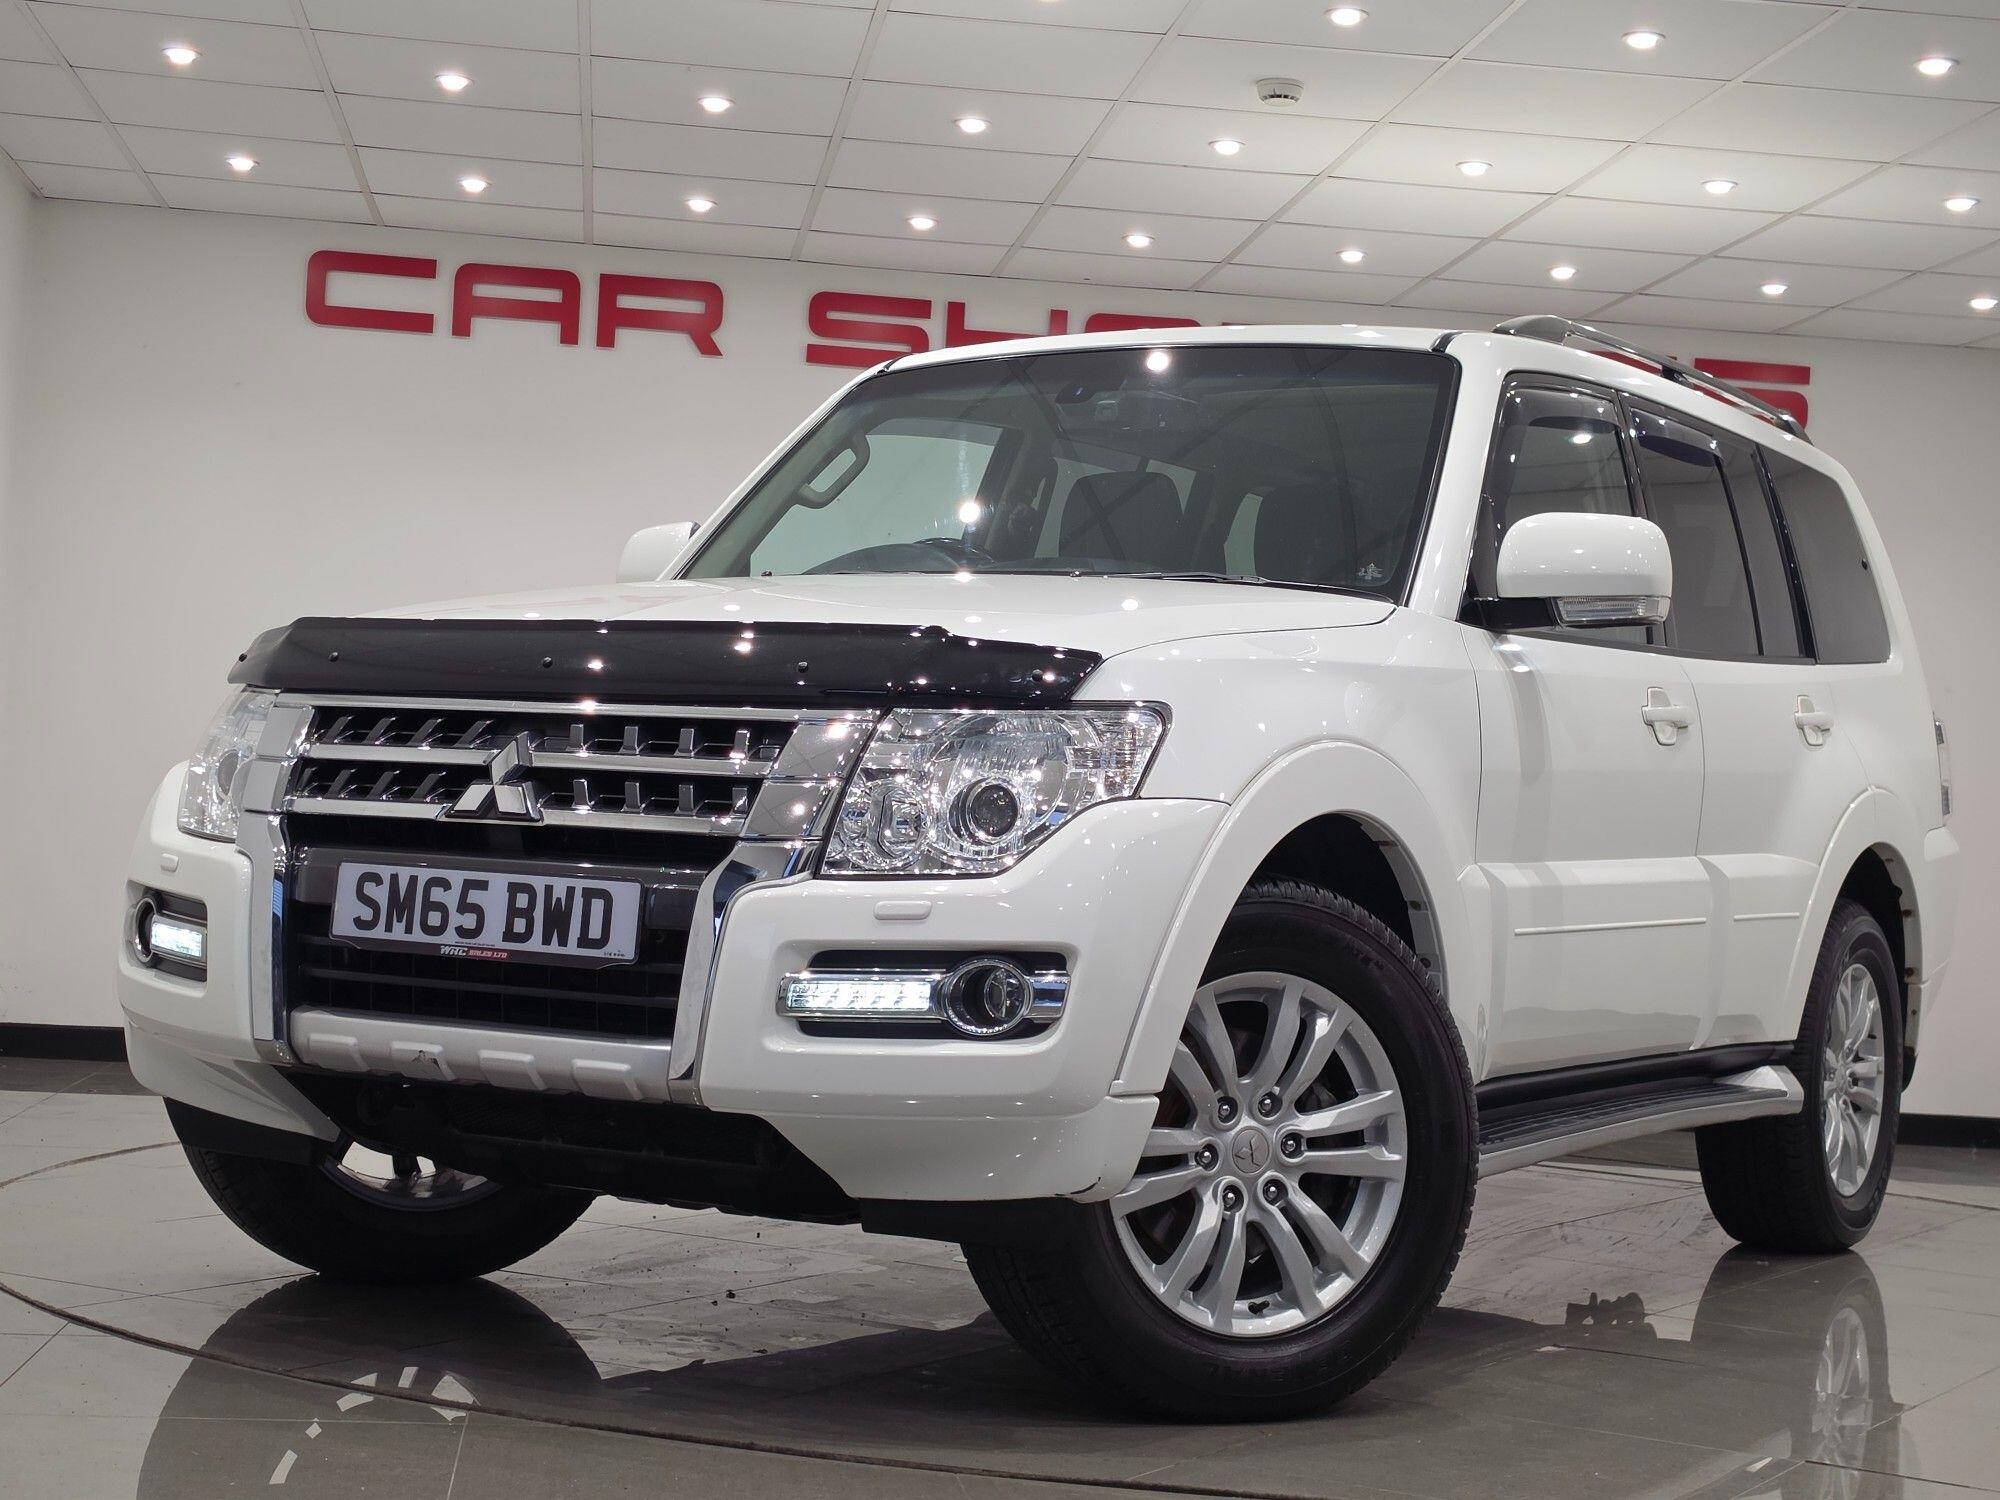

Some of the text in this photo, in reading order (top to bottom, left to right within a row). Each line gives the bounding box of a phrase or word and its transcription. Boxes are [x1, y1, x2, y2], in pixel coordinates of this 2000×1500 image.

[306, 250, 724, 357] CAR
[353, 871, 614, 950] SM65 BWD
